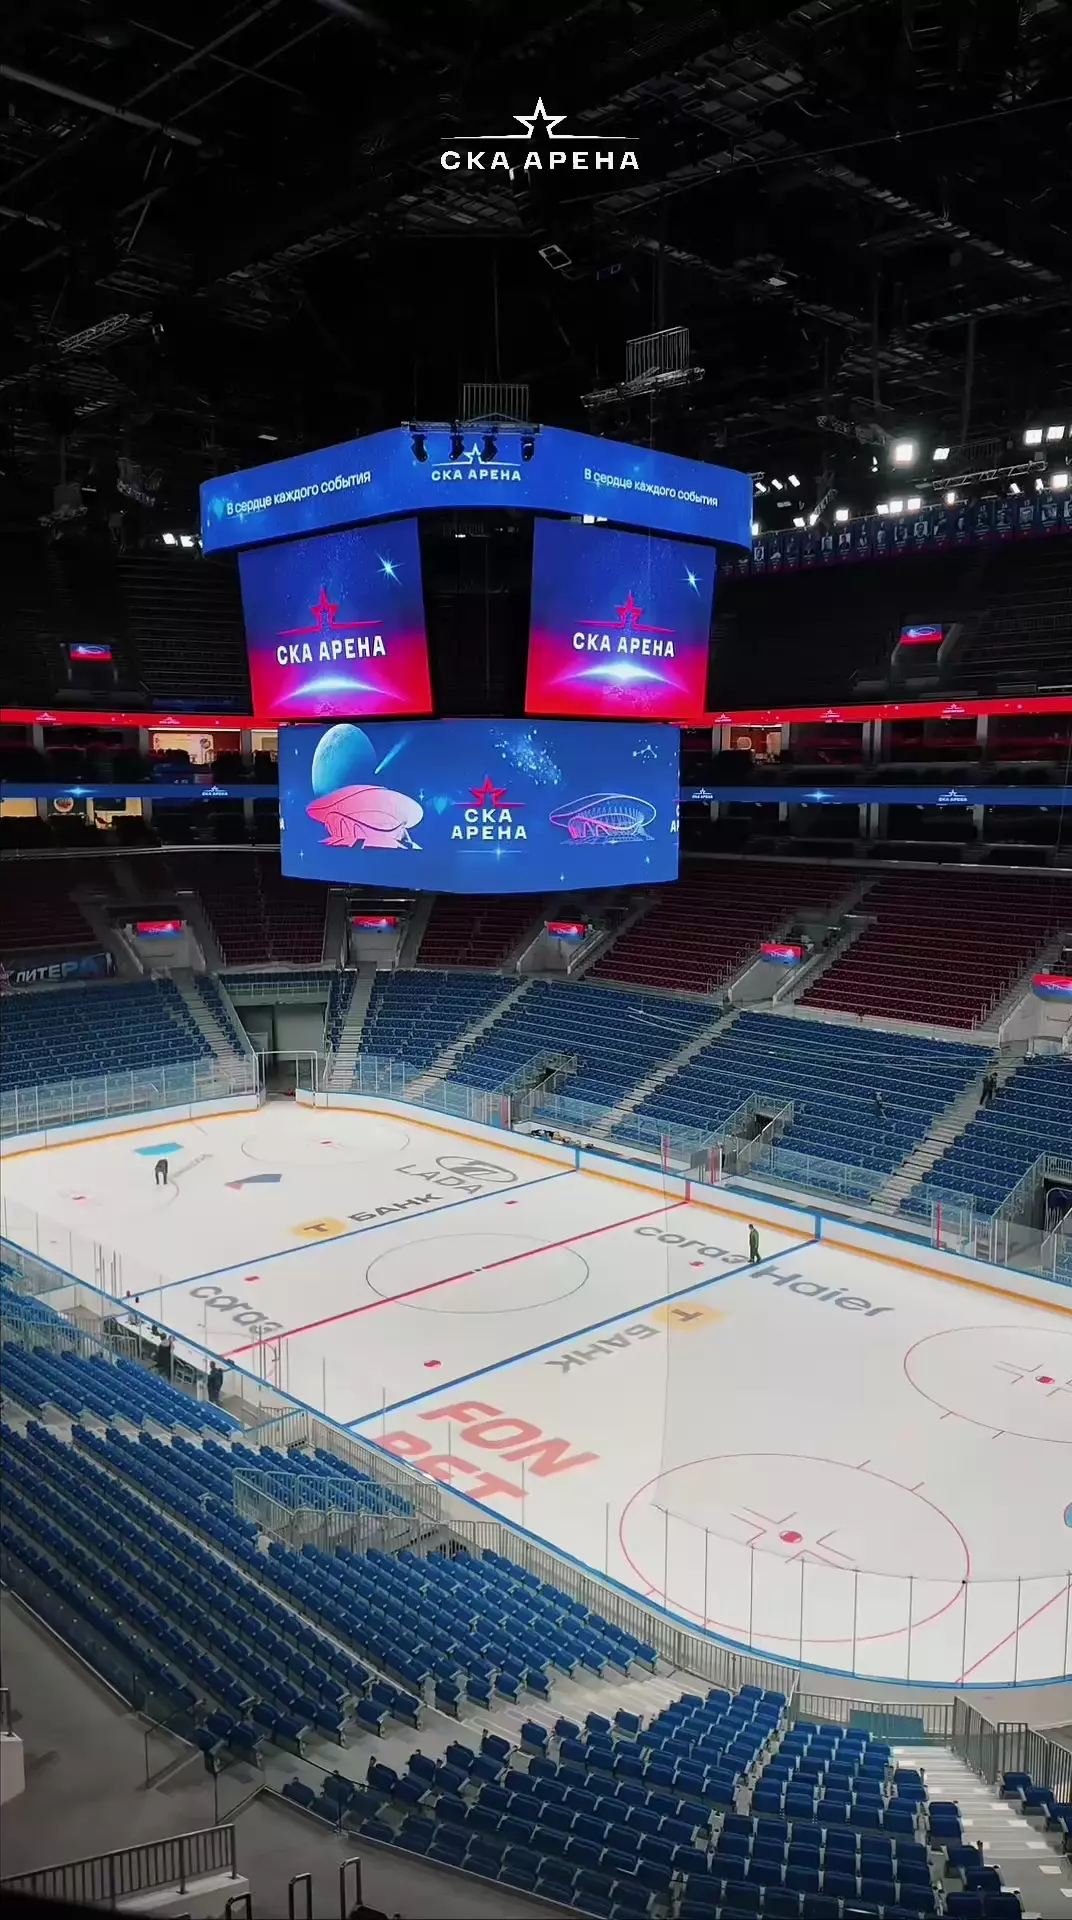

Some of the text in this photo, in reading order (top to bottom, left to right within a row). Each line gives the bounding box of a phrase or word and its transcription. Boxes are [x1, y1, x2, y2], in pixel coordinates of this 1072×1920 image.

[431, 469, 521, 481] СКА АРЕНА
[584, 467, 718, 507] В сердце каждого события
[227, 471, 371, 515] В сердце каждого события
[277, 635, 386, 665] СКА АРЕНА
[573, 632, 675, 658] СКА АРЕНА
[450, 825, 527, 840] АРЕНА
[464, 808, 513, 823] СКА
[395, 1164, 484, 1194] LADA
[303, 1193, 443, 1233] Т БАНК
[749, 1265, 896, 1317] Haier
[544, 1308, 704, 1374] Т БАНК
[417, 1400, 601, 1478] FON
